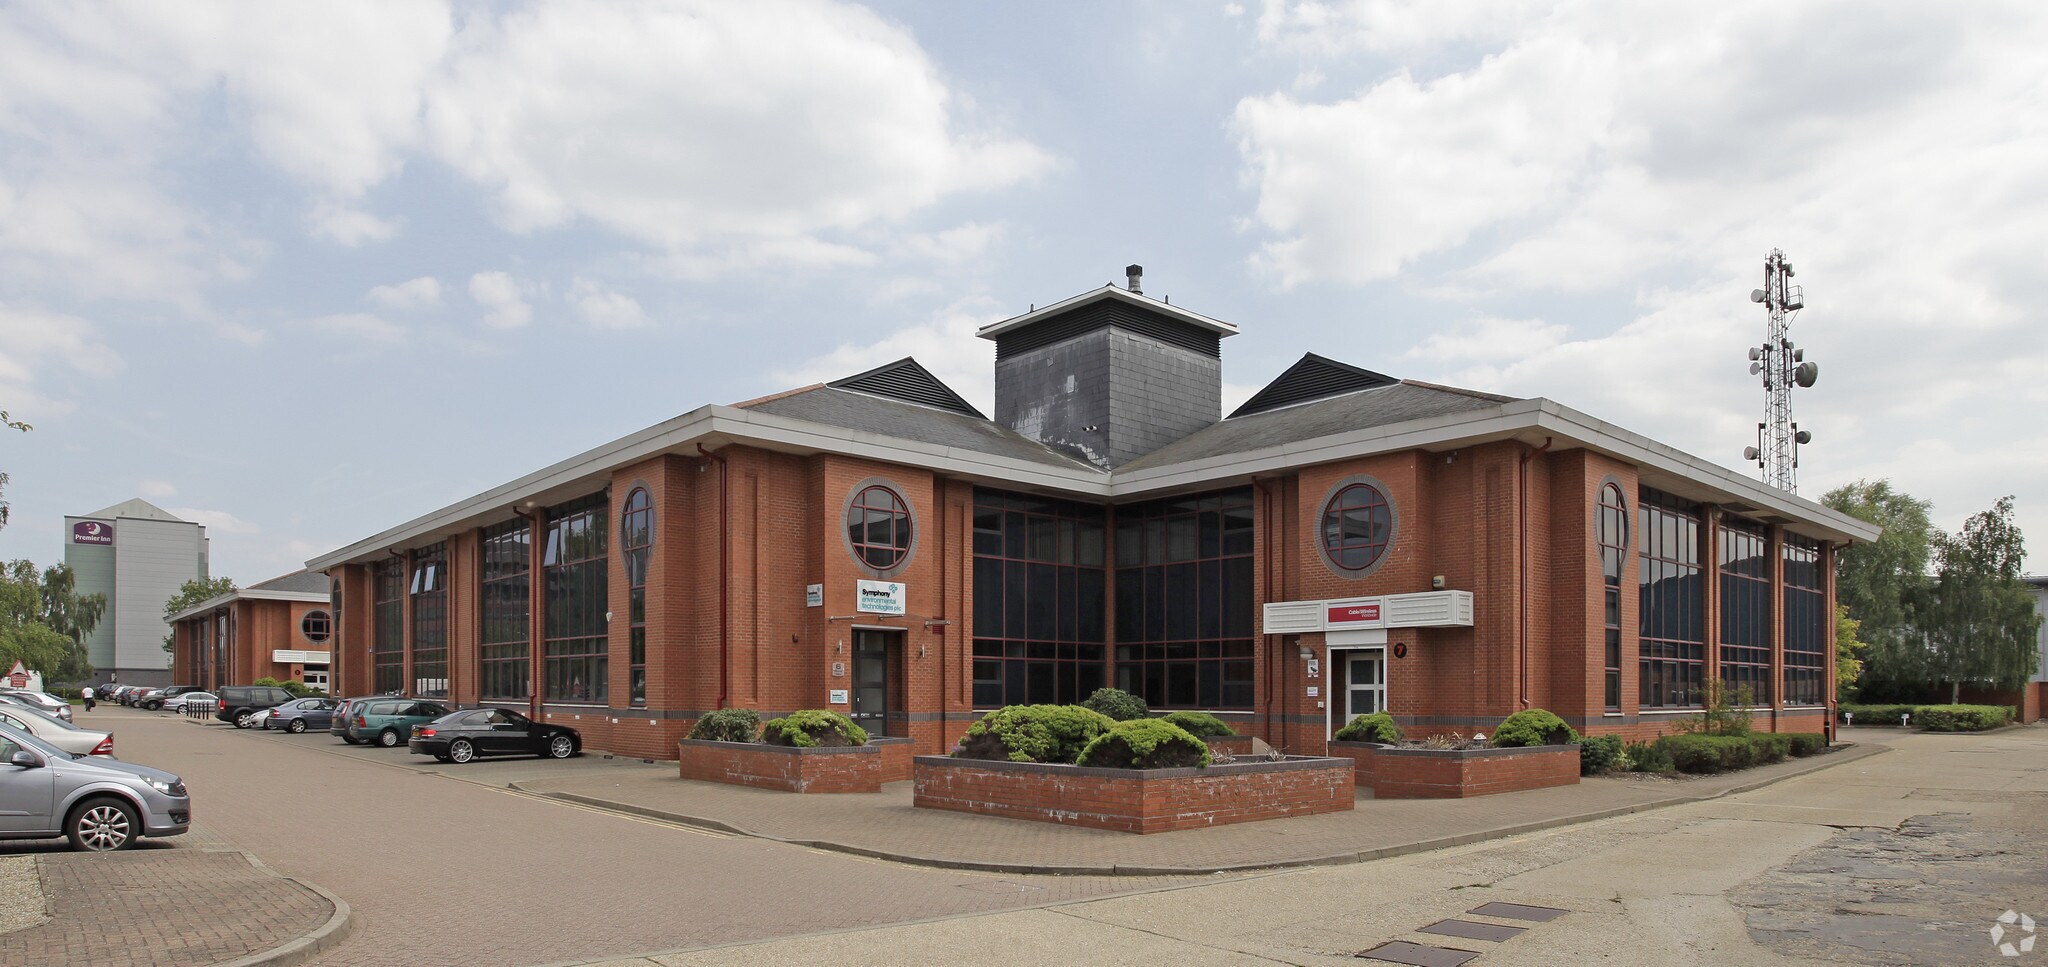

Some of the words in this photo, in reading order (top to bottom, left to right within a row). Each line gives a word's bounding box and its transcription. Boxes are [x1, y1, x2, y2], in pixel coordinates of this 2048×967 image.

[862, 589, 890, 598] Symphony
[862, 603, 893, 611] technologies
[1397, 645, 1404, 656] 7
